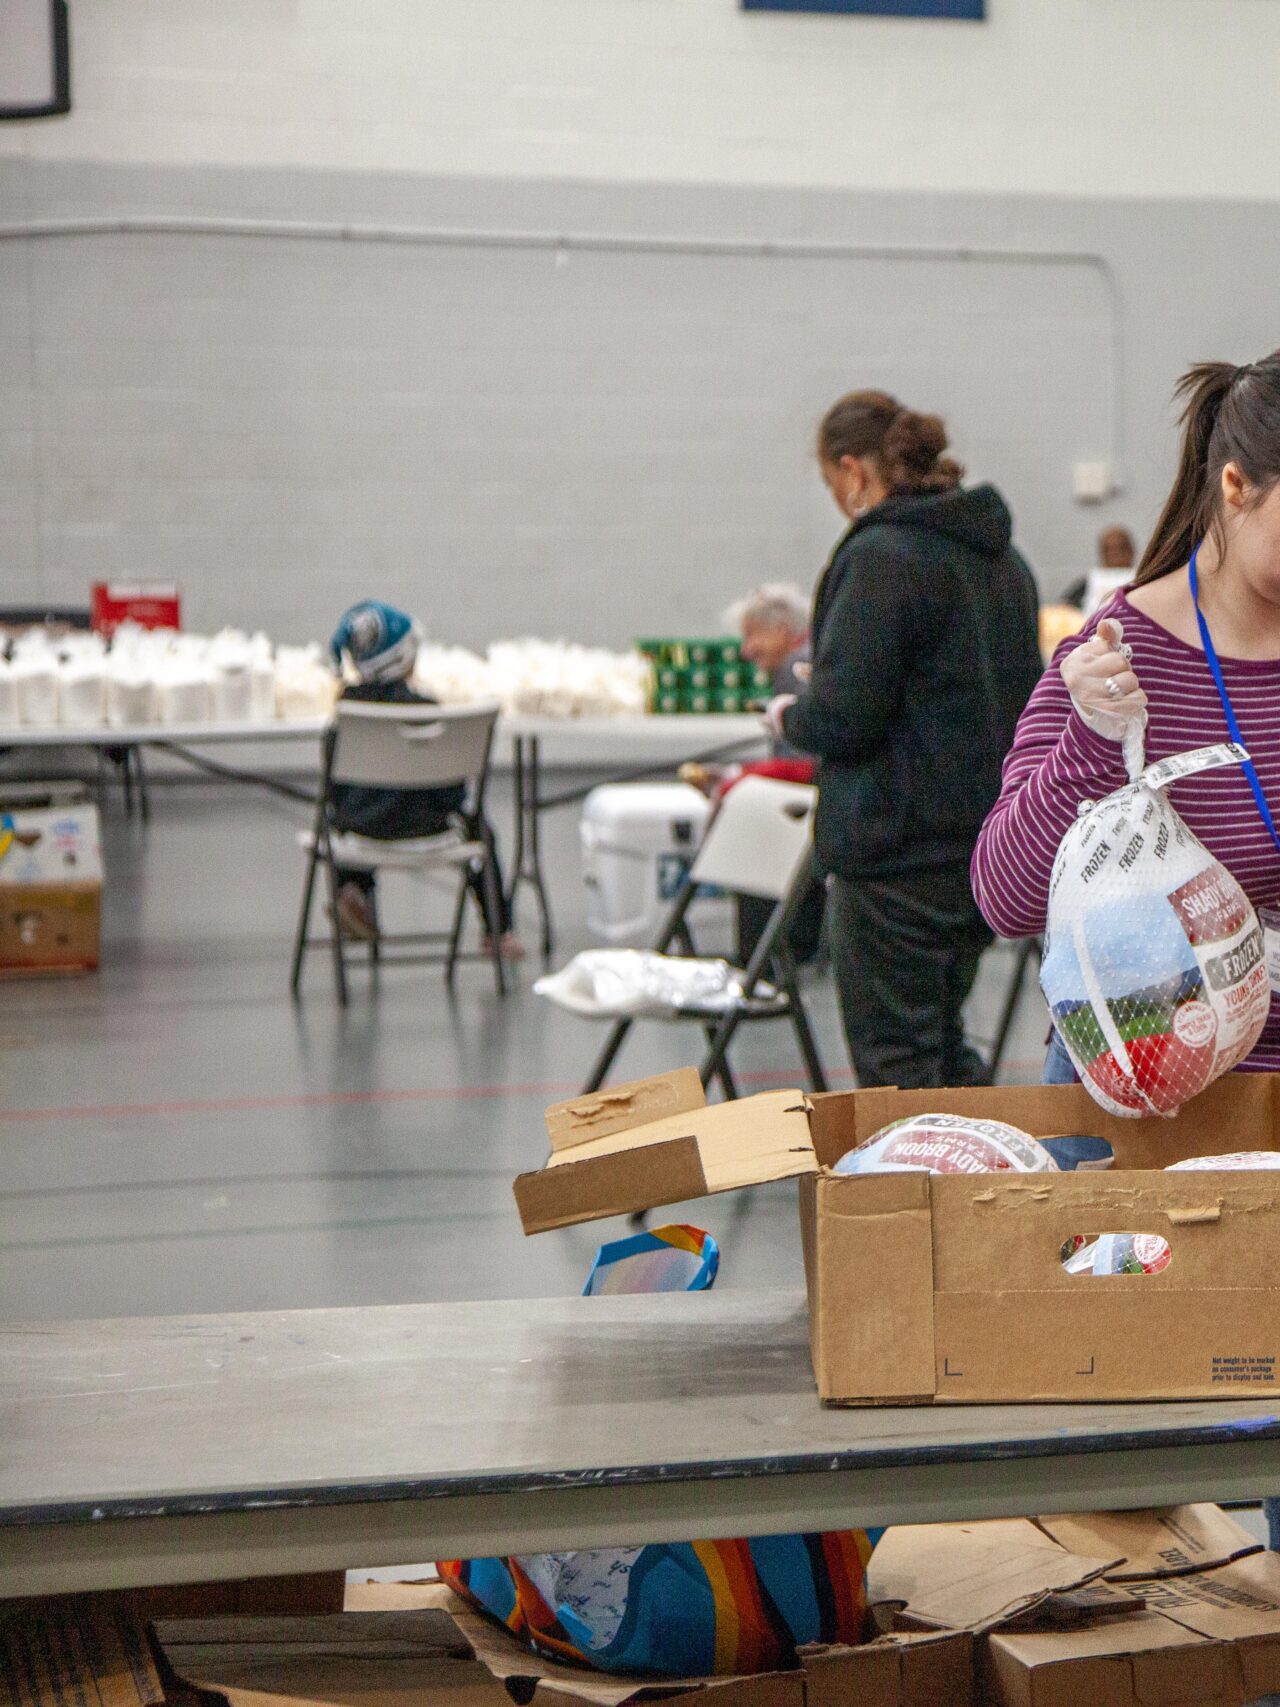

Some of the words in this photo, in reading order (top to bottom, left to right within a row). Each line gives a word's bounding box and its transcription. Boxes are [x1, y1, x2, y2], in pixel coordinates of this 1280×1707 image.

[1080, 839, 1112, 884] FROZEN
[1118, 831, 1145, 873] FROZEN
[1181, 883, 1221, 919] SHADY
[1222, 933, 1261, 982] FROZEN
[934, 1118, 1023, 1152] FROZEN
[935, 1135, 985, 1158] FARMS
[894, 1142, 948, 1158] BROOK
[950, 1150, 990, 1173] HADY
[1212, 1356, 1222, 1364] Net
[1222, 1356, 1240, 1365] weight
[1241, 1356, 1248, 1364] to
[1248, 1356, 1255, 1364] be
[1256, 1356, 1276, 1364] marked
[1220, 1365, 1249, 1373] consumer's
[1250, 1366, 1272, 1374] package
[1212, 1374, 1224, 1382] prior
[1232, 1374, 1251, 1382] display
[1157, 1546, 1194, 1567] ABEL
